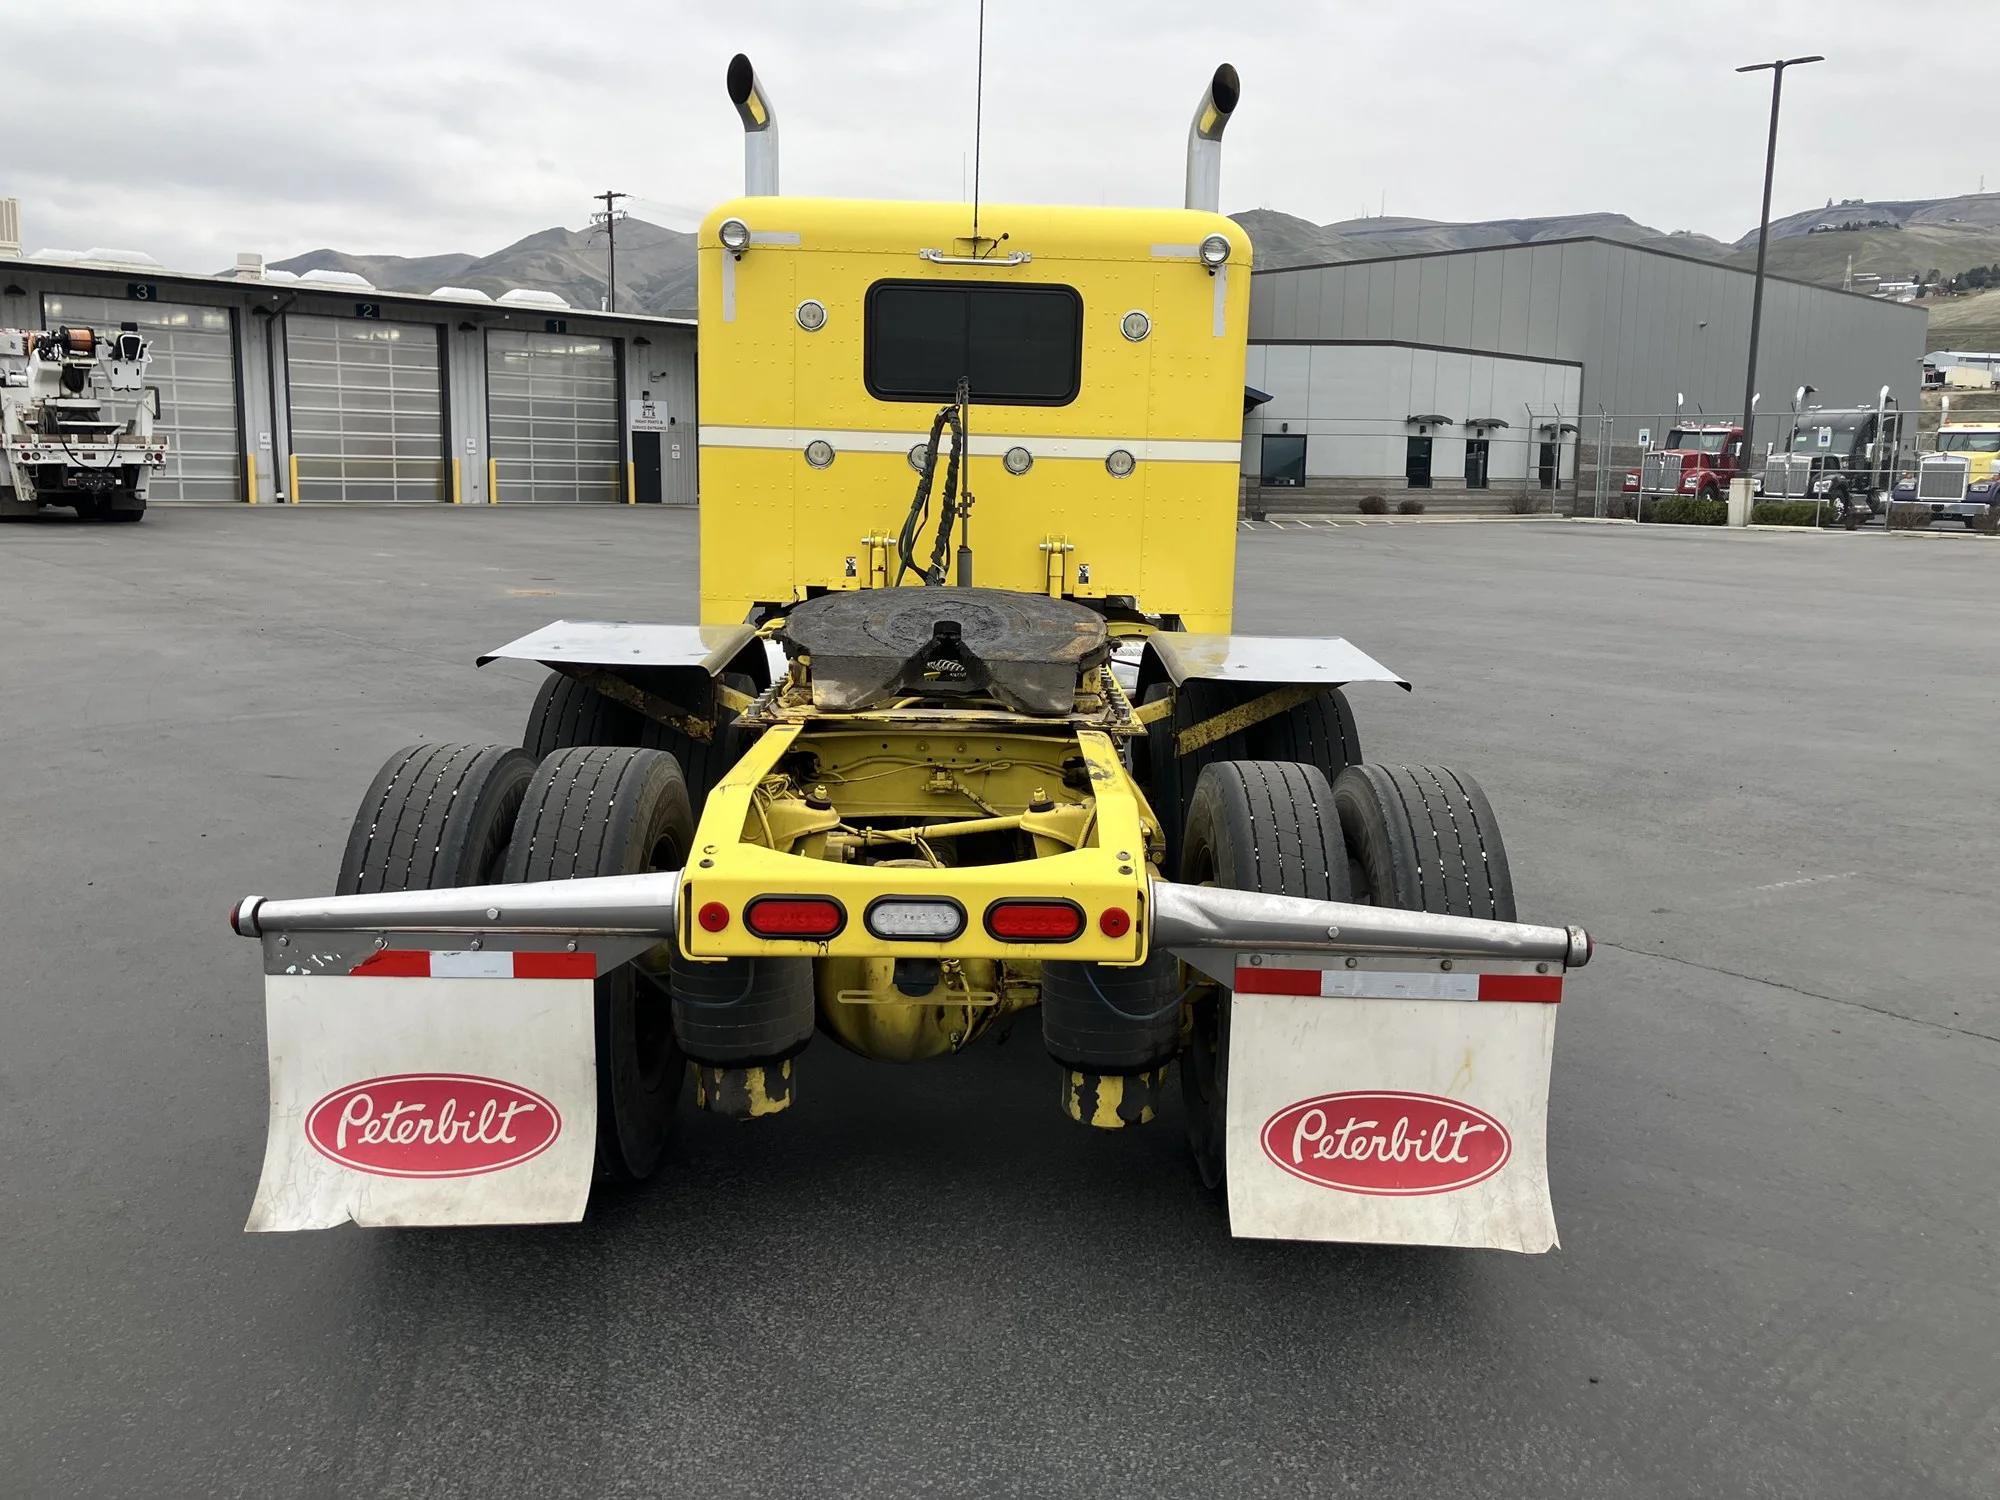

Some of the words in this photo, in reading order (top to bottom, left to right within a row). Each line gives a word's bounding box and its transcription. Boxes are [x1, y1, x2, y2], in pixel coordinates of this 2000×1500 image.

[137, 284, 149, 300] 3
[364, 303, 373, 318] 2
[554, 319, 560, 333] 1
[337, 1093, 537, 1150] Peterbilt
[1293, 1109, 1487, 1165] Peterbilt
